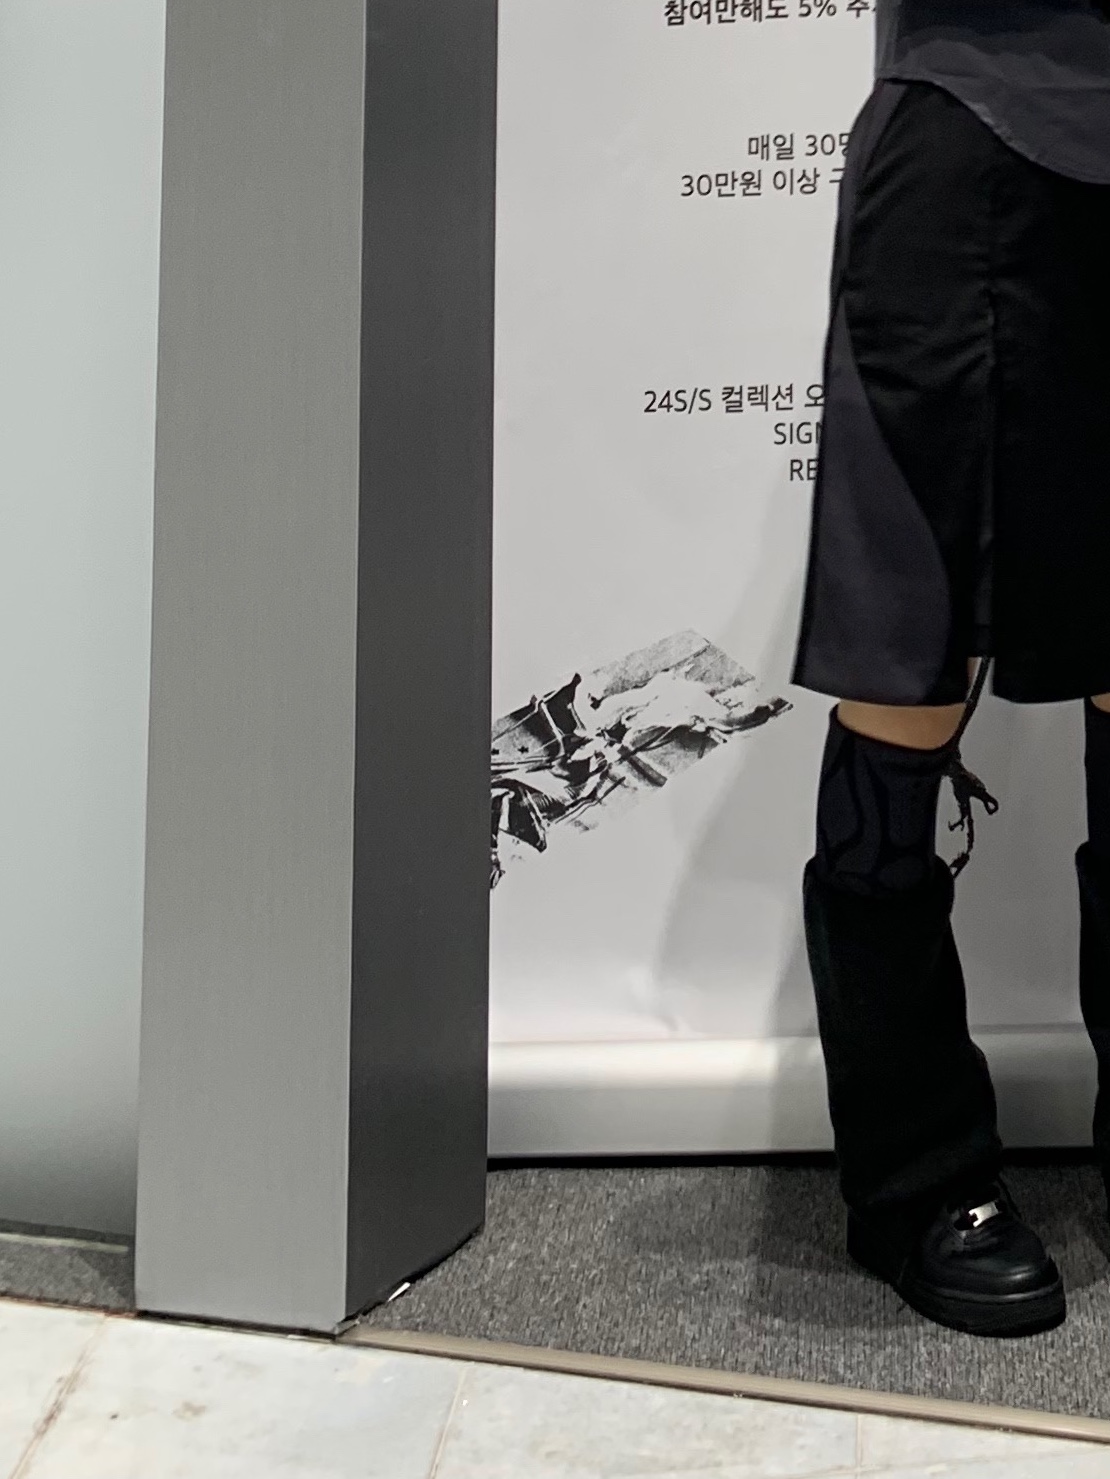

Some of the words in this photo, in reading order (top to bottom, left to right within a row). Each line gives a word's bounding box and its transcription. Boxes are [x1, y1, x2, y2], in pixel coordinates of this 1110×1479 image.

[748, 132, 794, 161] 매일
[681, 170, 762, 197] 30만원
[773, 168, 820, 195] 이상
[643, 387, 712, 414] 24S/S
[721, 383, 794, 413] 컬렉션
